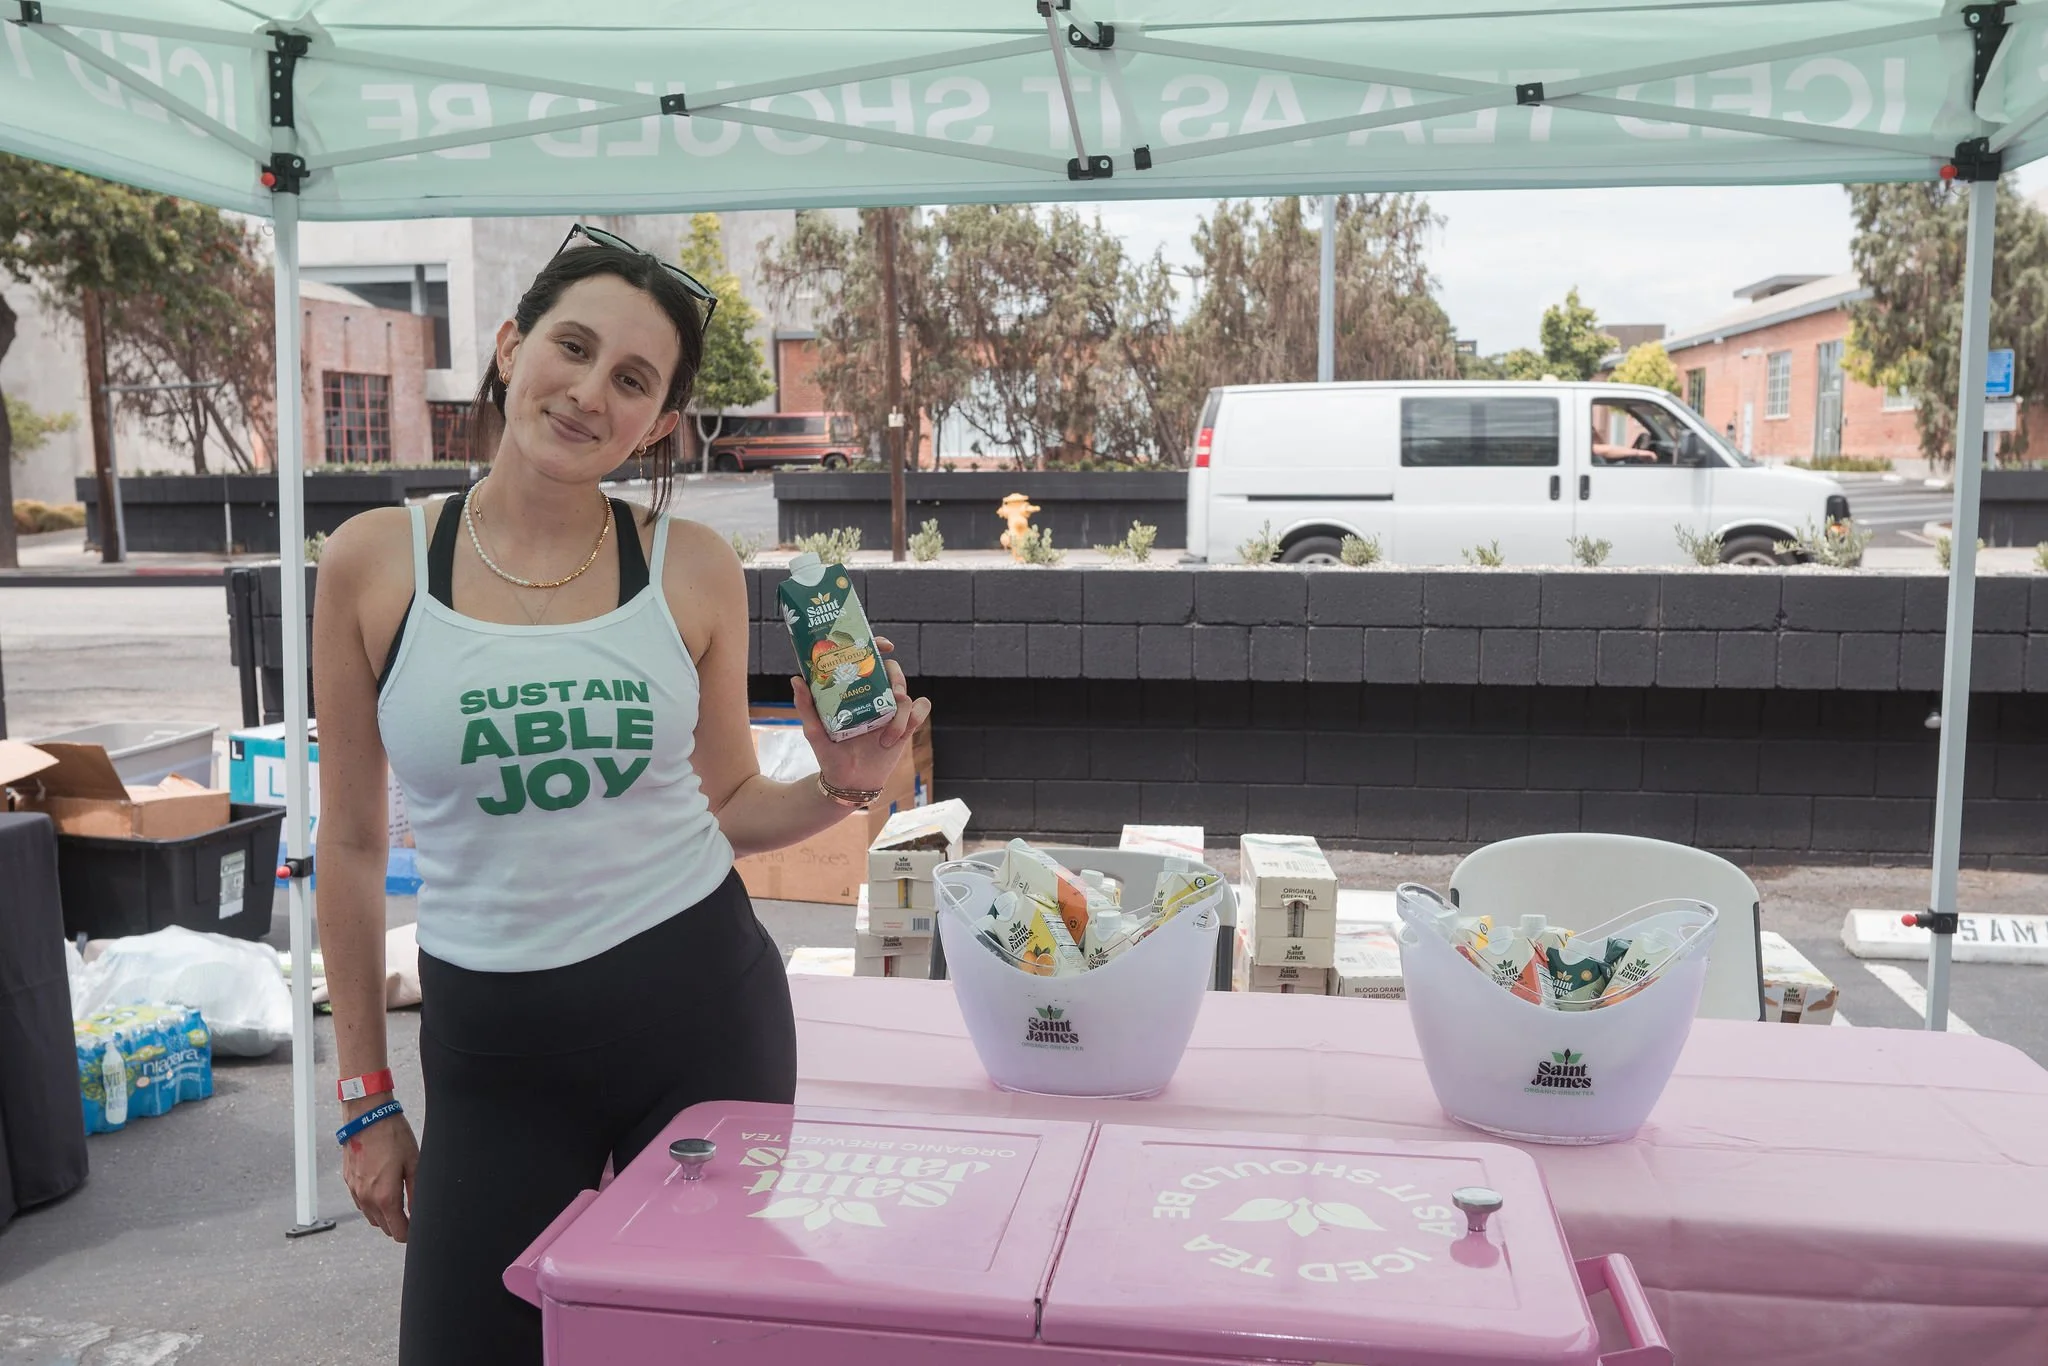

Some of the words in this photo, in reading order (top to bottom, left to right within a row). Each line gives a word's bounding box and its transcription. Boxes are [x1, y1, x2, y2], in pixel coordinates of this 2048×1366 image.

[806, 598, 841, 618] Saint
[808, 607, 847, 628] James
[460, 679, 650, 715] SUSTAIN
[840, 684, 871, 700] MANGO
[461, 707, 654, 765] ABLE
[231, 741, 243, 760] L
[476, 757, 651, 816] JOY
[1008, 925, 1029, 944] Saint
[1958, 919, 2048, 945] SAM
[1028, 1017, 1072, 1032] Saint
[1026, 1030, 1079, 1044] James
[1538, 1060, 1588, 1077] Saint
[1524, 1087, 1557, 1096] ORGANIC
[1558, 1089, 1580, 1097] GREEN
[1531, 1075, 1592, 1089] James
[361, 1102, 401, 1125] #LASTRO
[741, 1132, 782, 1143] TEA
[790, 1135, 897, 1150] BREWED
[900, 1142, 1017, 1159] ORGANIC
[739, 1147, 992, 1183] James
[1180, 1159, 1383, 1190] SHOULD
[743, 1169, 958, 1209] Saint
[1377, 1182, 1433, 1203] IT
[1153, 1189, 1197, 1219] BE
[1412, 1204, 1458, 1238] AS
[1183, 1233, 1275, 1278] TEA
[1297, 1246, 1434, 1282] ICED
